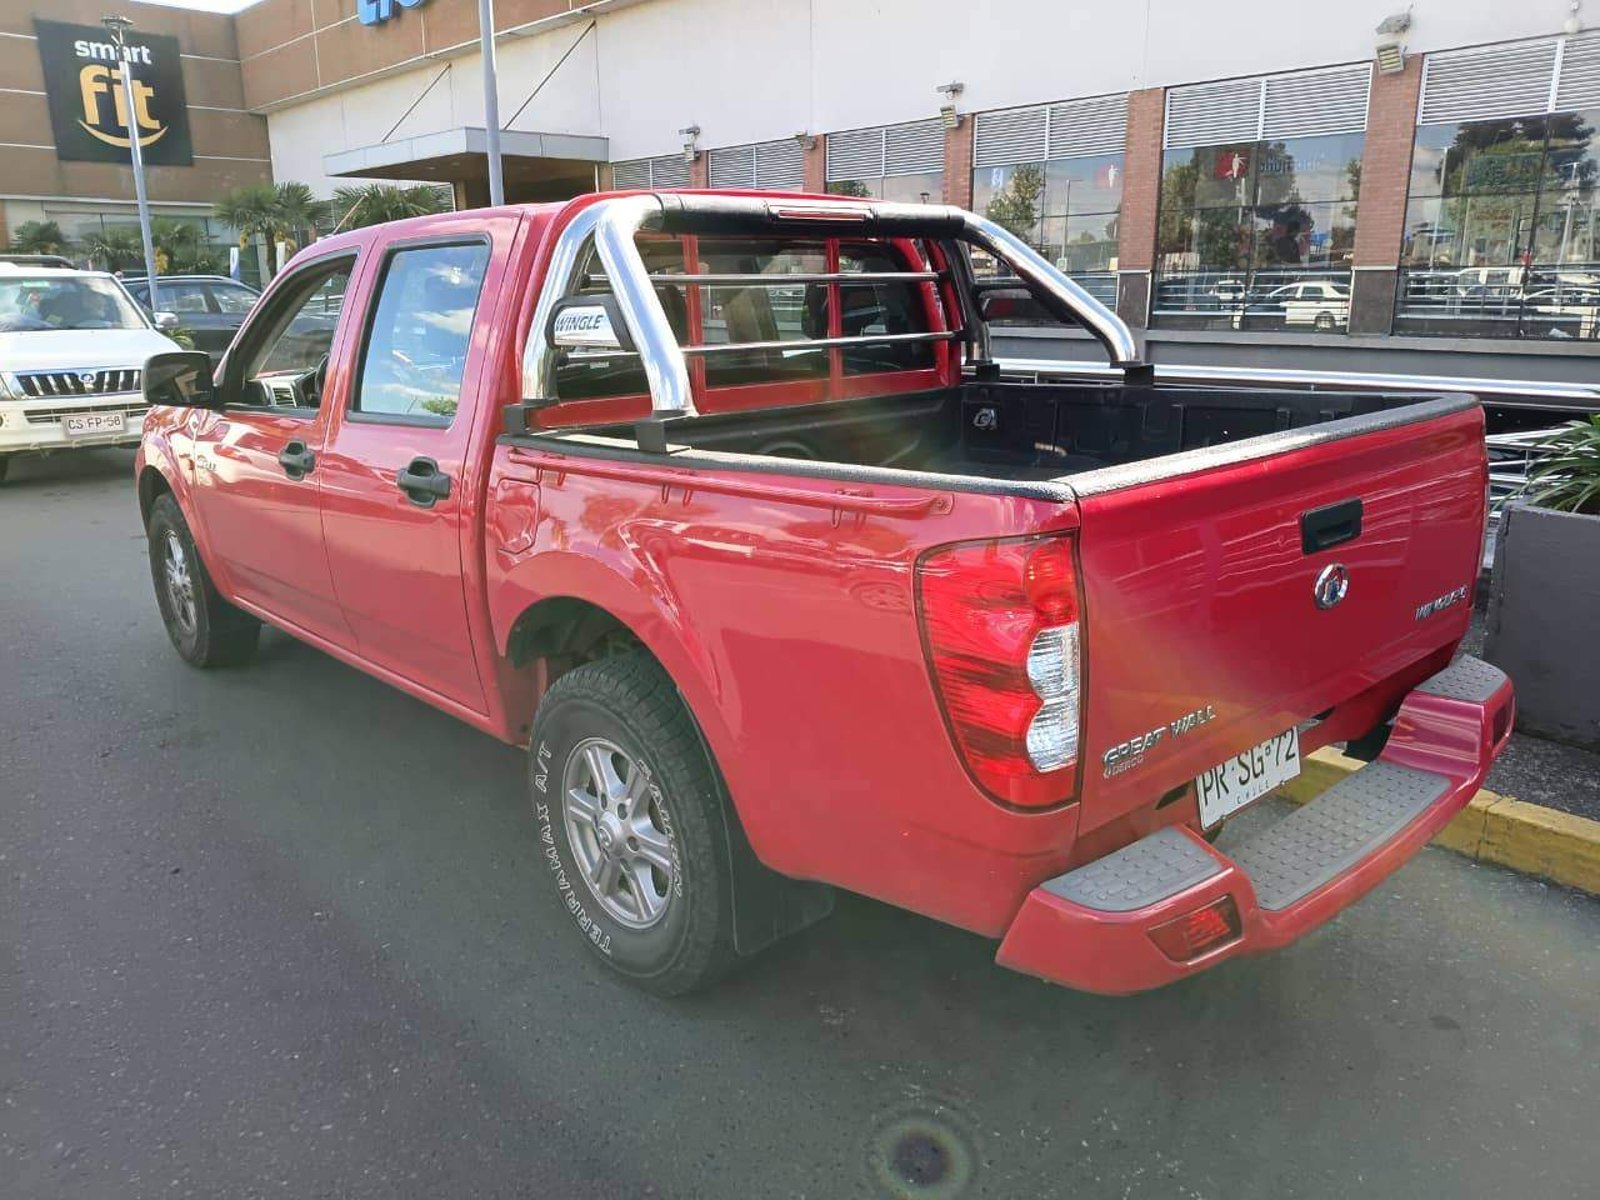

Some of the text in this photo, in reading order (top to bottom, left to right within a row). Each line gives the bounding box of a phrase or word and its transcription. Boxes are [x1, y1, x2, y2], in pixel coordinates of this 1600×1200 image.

[79, 64, 161, 130] fit
[555, 314, 604, 332] WINGLE
[1103, 705, 1217, 765] GREAT WALL
